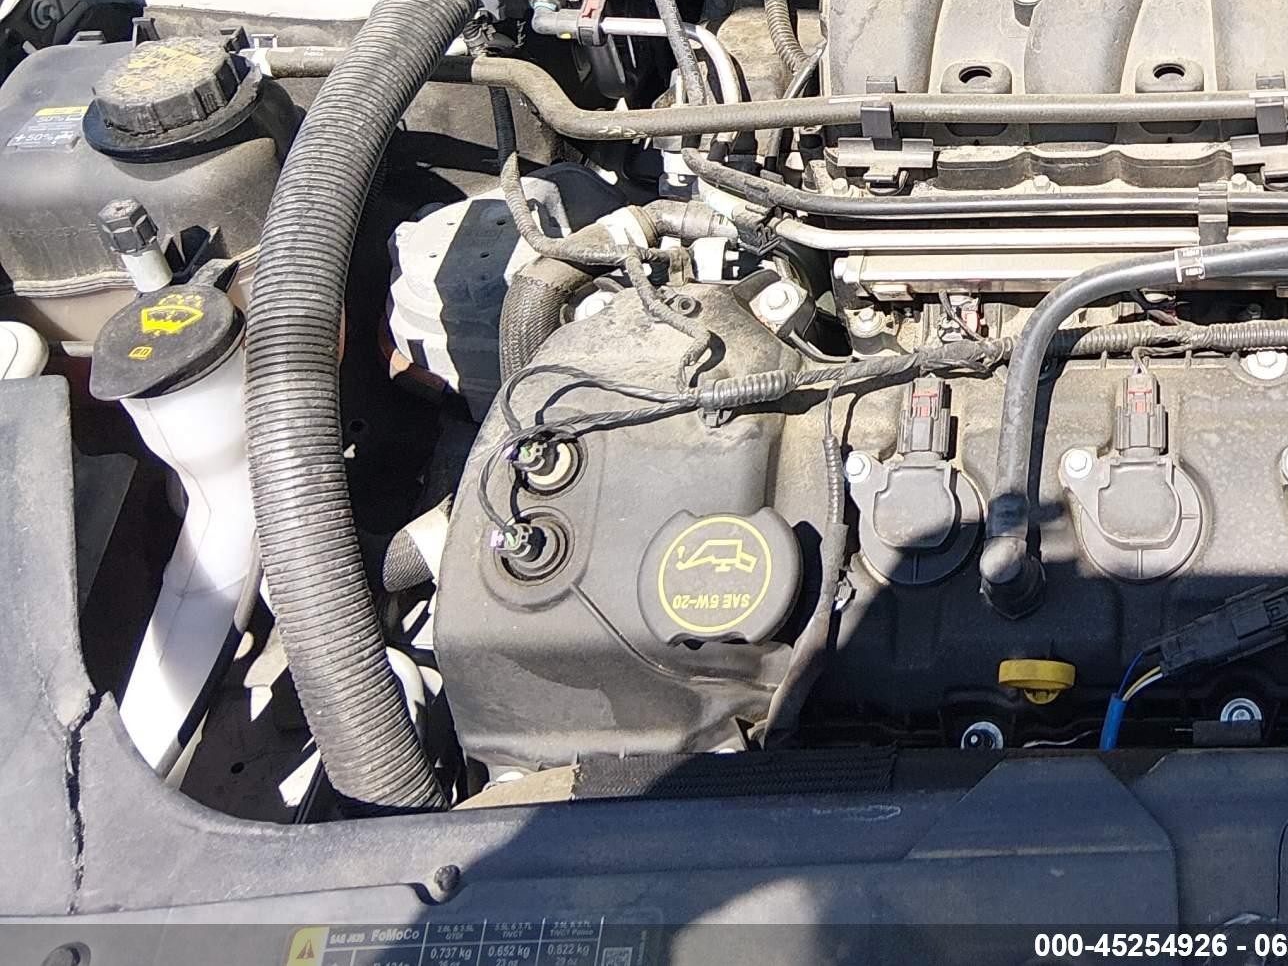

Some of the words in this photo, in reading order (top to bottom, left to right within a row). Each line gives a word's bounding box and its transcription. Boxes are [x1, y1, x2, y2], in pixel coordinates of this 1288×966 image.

[672, 594, 720, 610] 5W-20
[722, 594, 750, 609] SAE
[371, 928, 420, 942] FoMoCo
[430, 946, 458, 959] 0.737
[460, 946, 473, 961] kg
[488, 945, 516, 957] 0.652
[517, 945, 531, 959] kg
[547, 944, 575, 955] 0.822
[577, 943, 590, 956] kg
